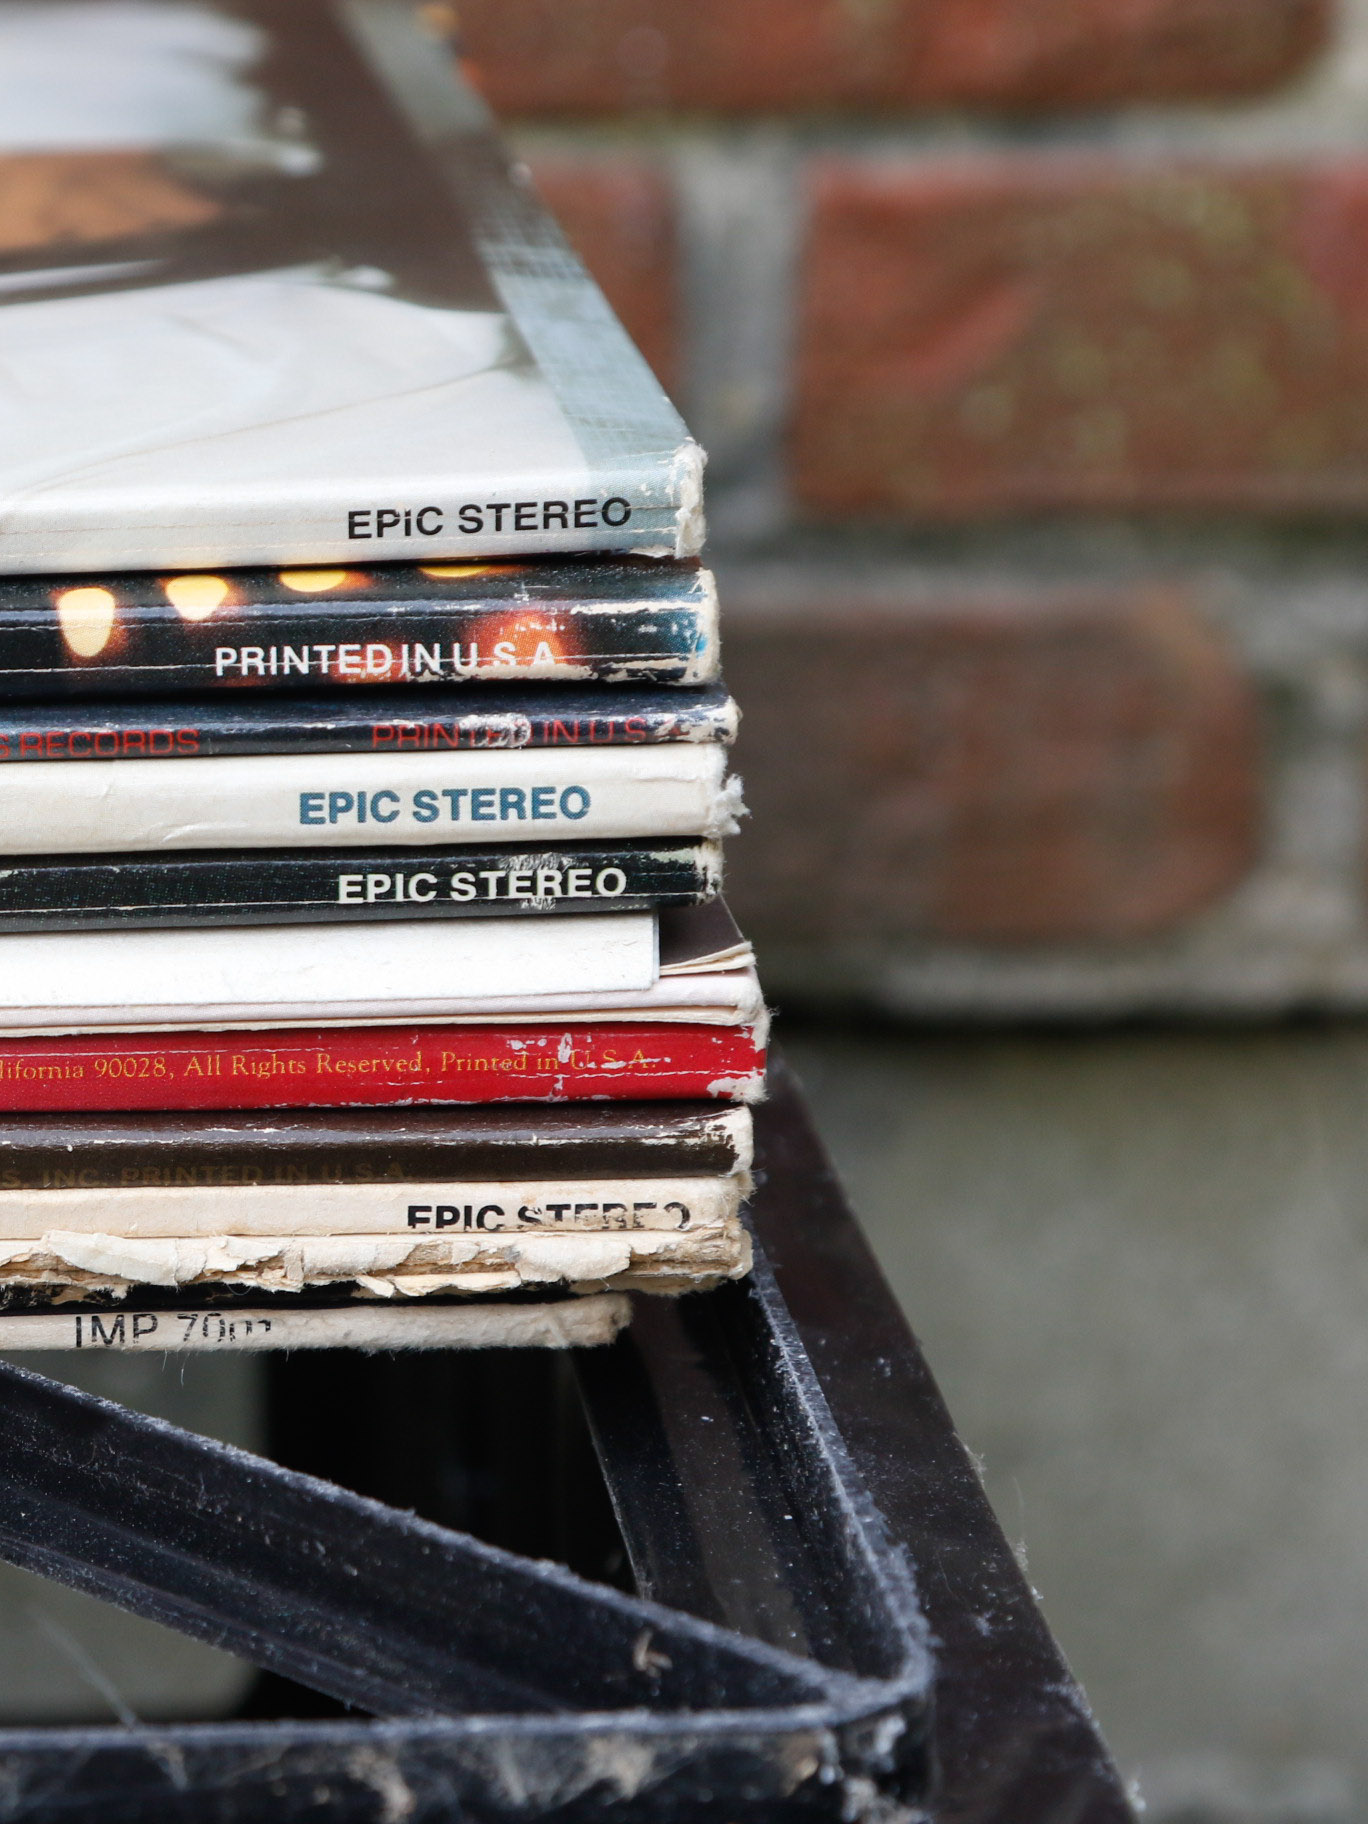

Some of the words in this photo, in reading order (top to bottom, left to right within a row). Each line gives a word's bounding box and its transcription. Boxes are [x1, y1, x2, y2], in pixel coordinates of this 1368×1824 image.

[348, 506, 444, 540] EPIC
[458, 497, 632, 533] STEREO
[215, 643, 393, 676] PRINTED
[401, 642, 441, 674] IN
[19, 728, 201, 757] RECORDS
[543, 718, 580, 744] IN
[298, 790, 401, 826] EPIC
[412, 785, 592, 822] STEREO
[337, 871, 438, 906] EPIC
[450, 866, 628, 902] STEREO
[94, 1055, 175, 1081] 90028,
[183, 1054, 222, 1077] All
[232, 1053, 307, 1080] Rights
[440, 1049, 529, 1072] Printed
[537, 1050, 560, 1071] in
[120, 1164, 264, 1186] PRINTED
[273, 1163, 309, 1184] IN
[407, 1203, 506, 1231] EPIC
[75, 1312, 159, 1348] IMP
